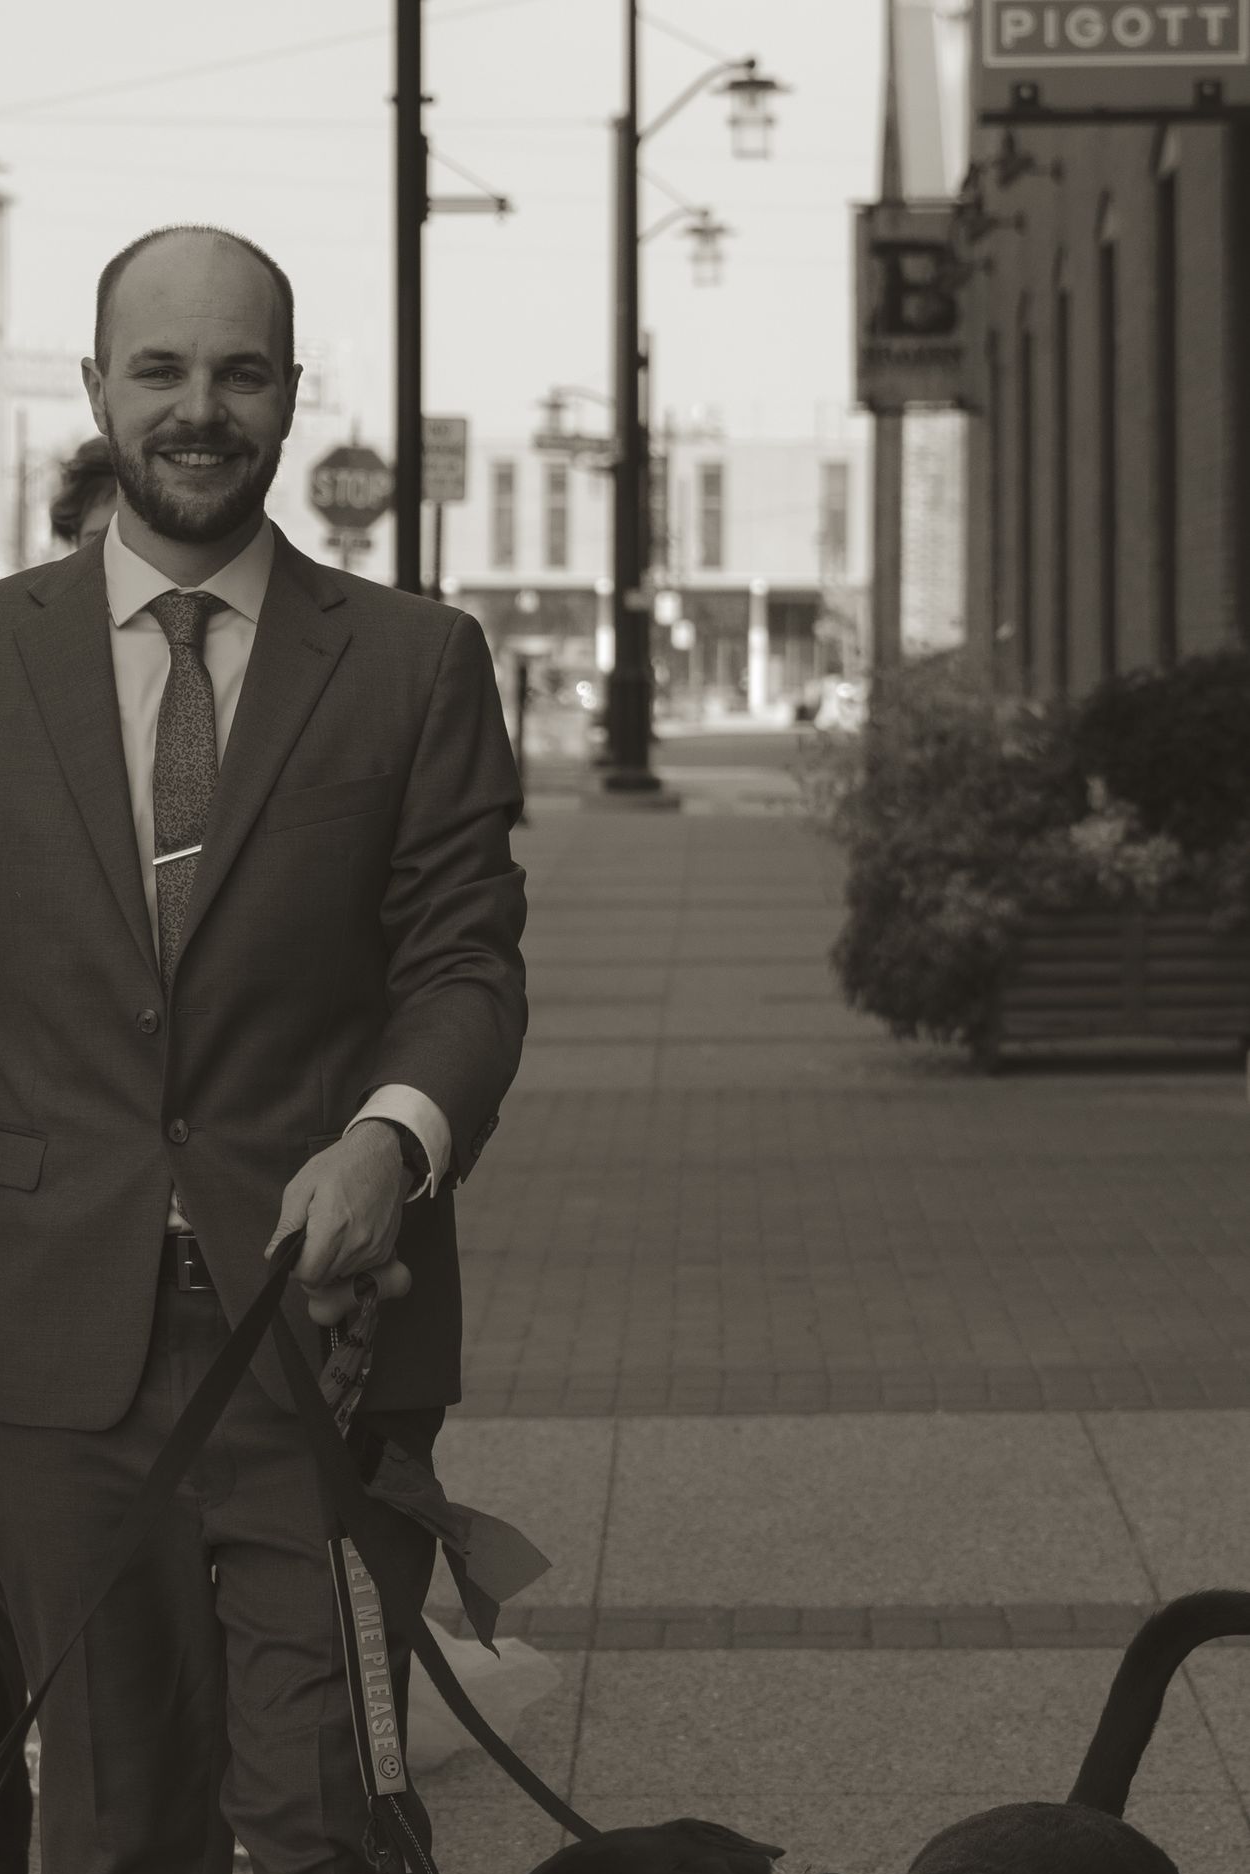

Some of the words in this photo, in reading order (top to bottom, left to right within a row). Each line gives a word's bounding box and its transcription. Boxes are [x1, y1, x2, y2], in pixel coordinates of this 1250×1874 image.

[1000, 6, 1232, 48] PIGOTT
[869, 240, 957, 334] B
[314, 468, 392, 510] STOP
[357, 1603, 383, 1644] ME
[363, 1651, 398, 1752] PLEASE
